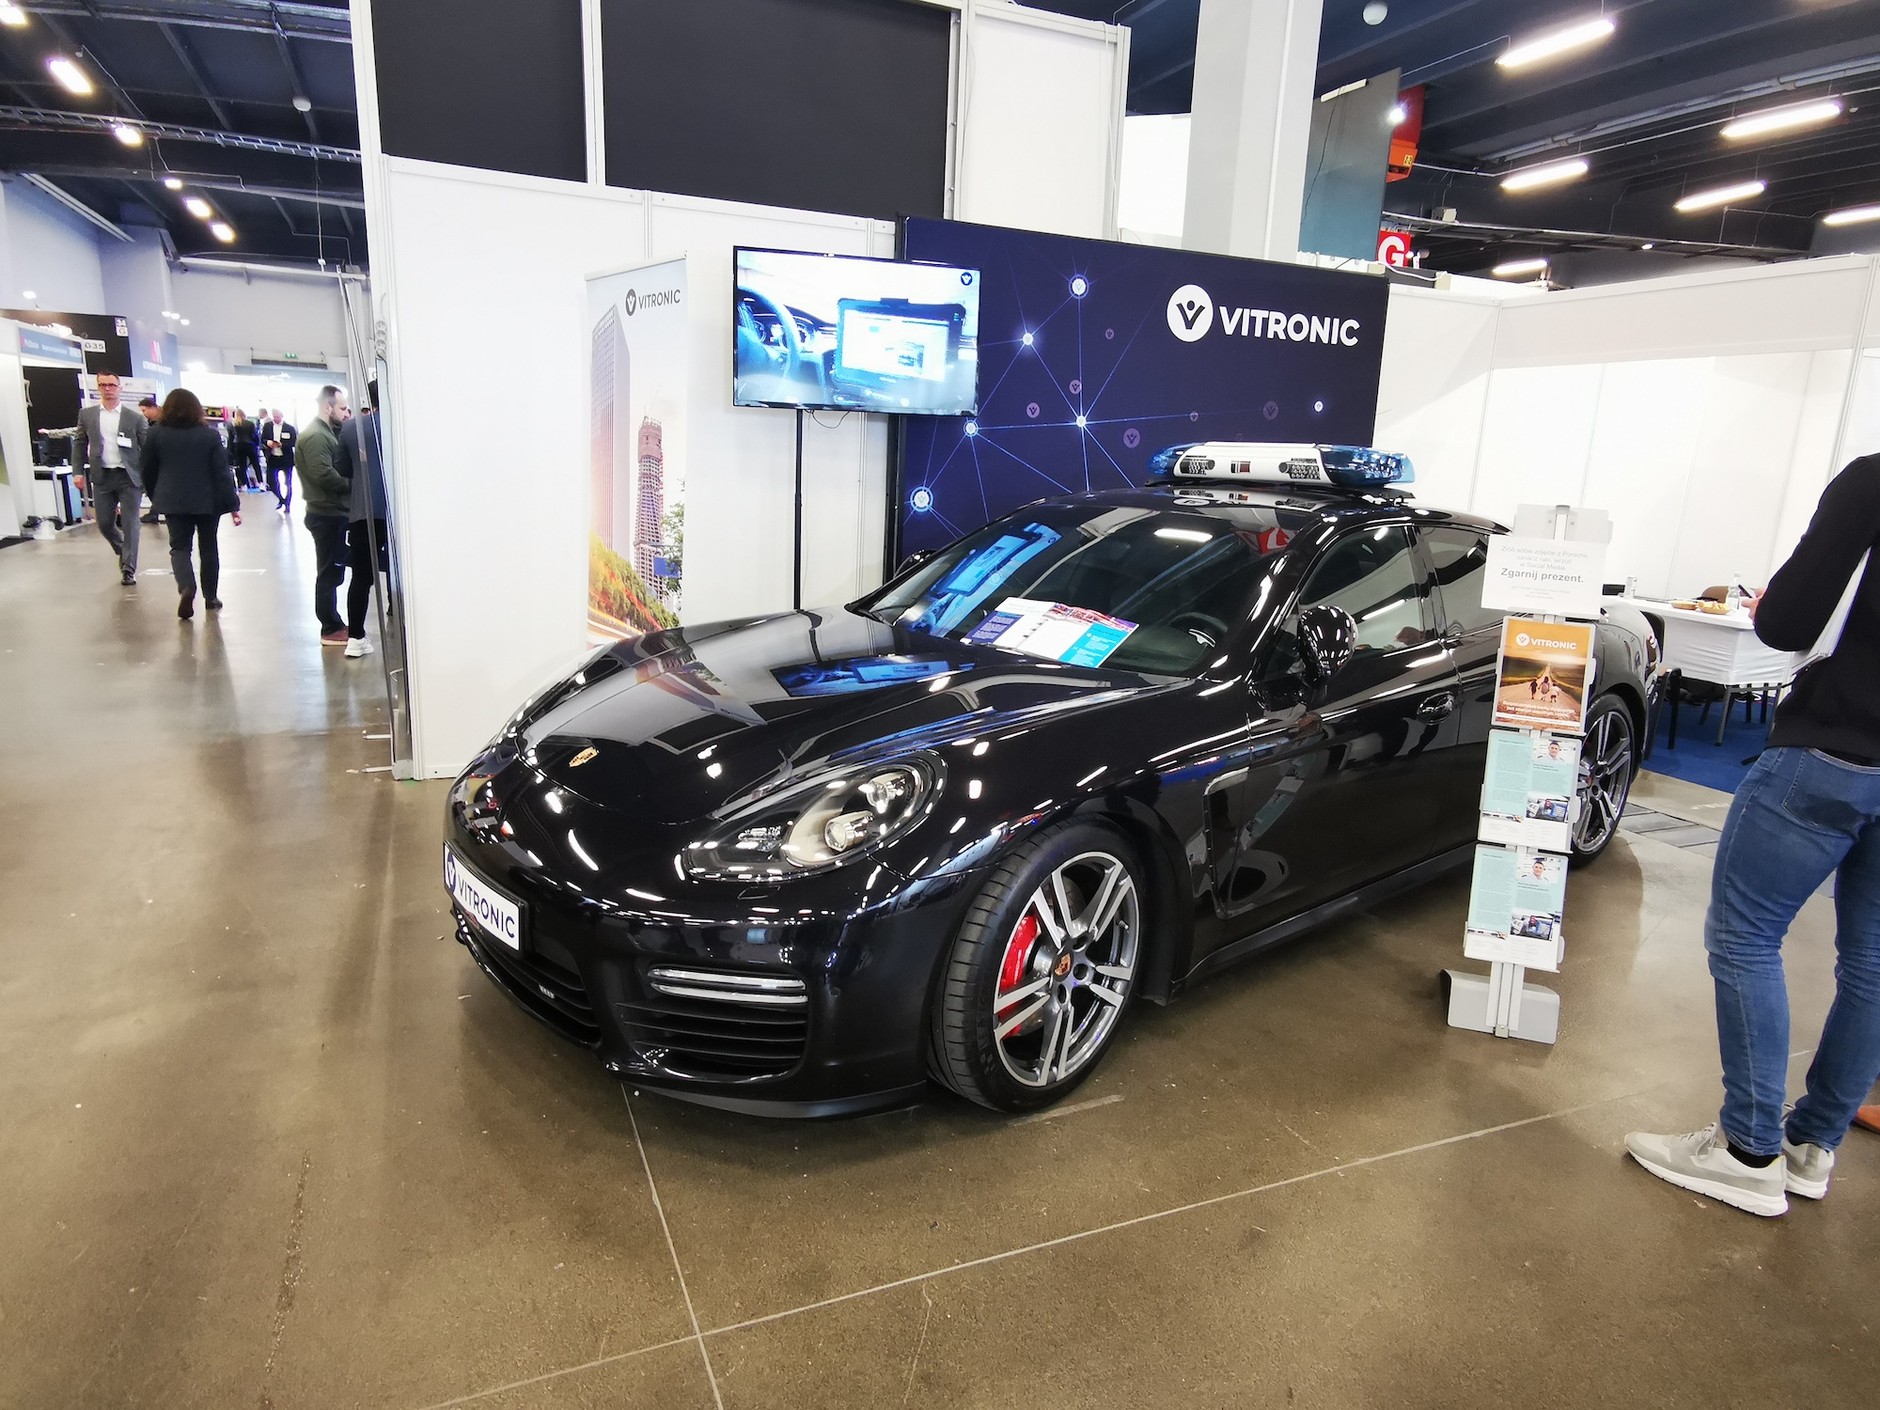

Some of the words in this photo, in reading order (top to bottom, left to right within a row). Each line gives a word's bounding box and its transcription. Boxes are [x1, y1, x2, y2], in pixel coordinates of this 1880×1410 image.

[1378, 235, 1405, 267] G
[638, 289, 681, 310] VITRONIC
[1219, 306, 1361, 347] VITRONIC
[84, 342, 104, 350] G35
[1501, 568, 1538, 580] Zgarnij
[1541, 572, 1584, 583] prezent.
[1531, 638, 1577, 650] VITRONIC
[458, 873, 516, 939] VITRONIC
